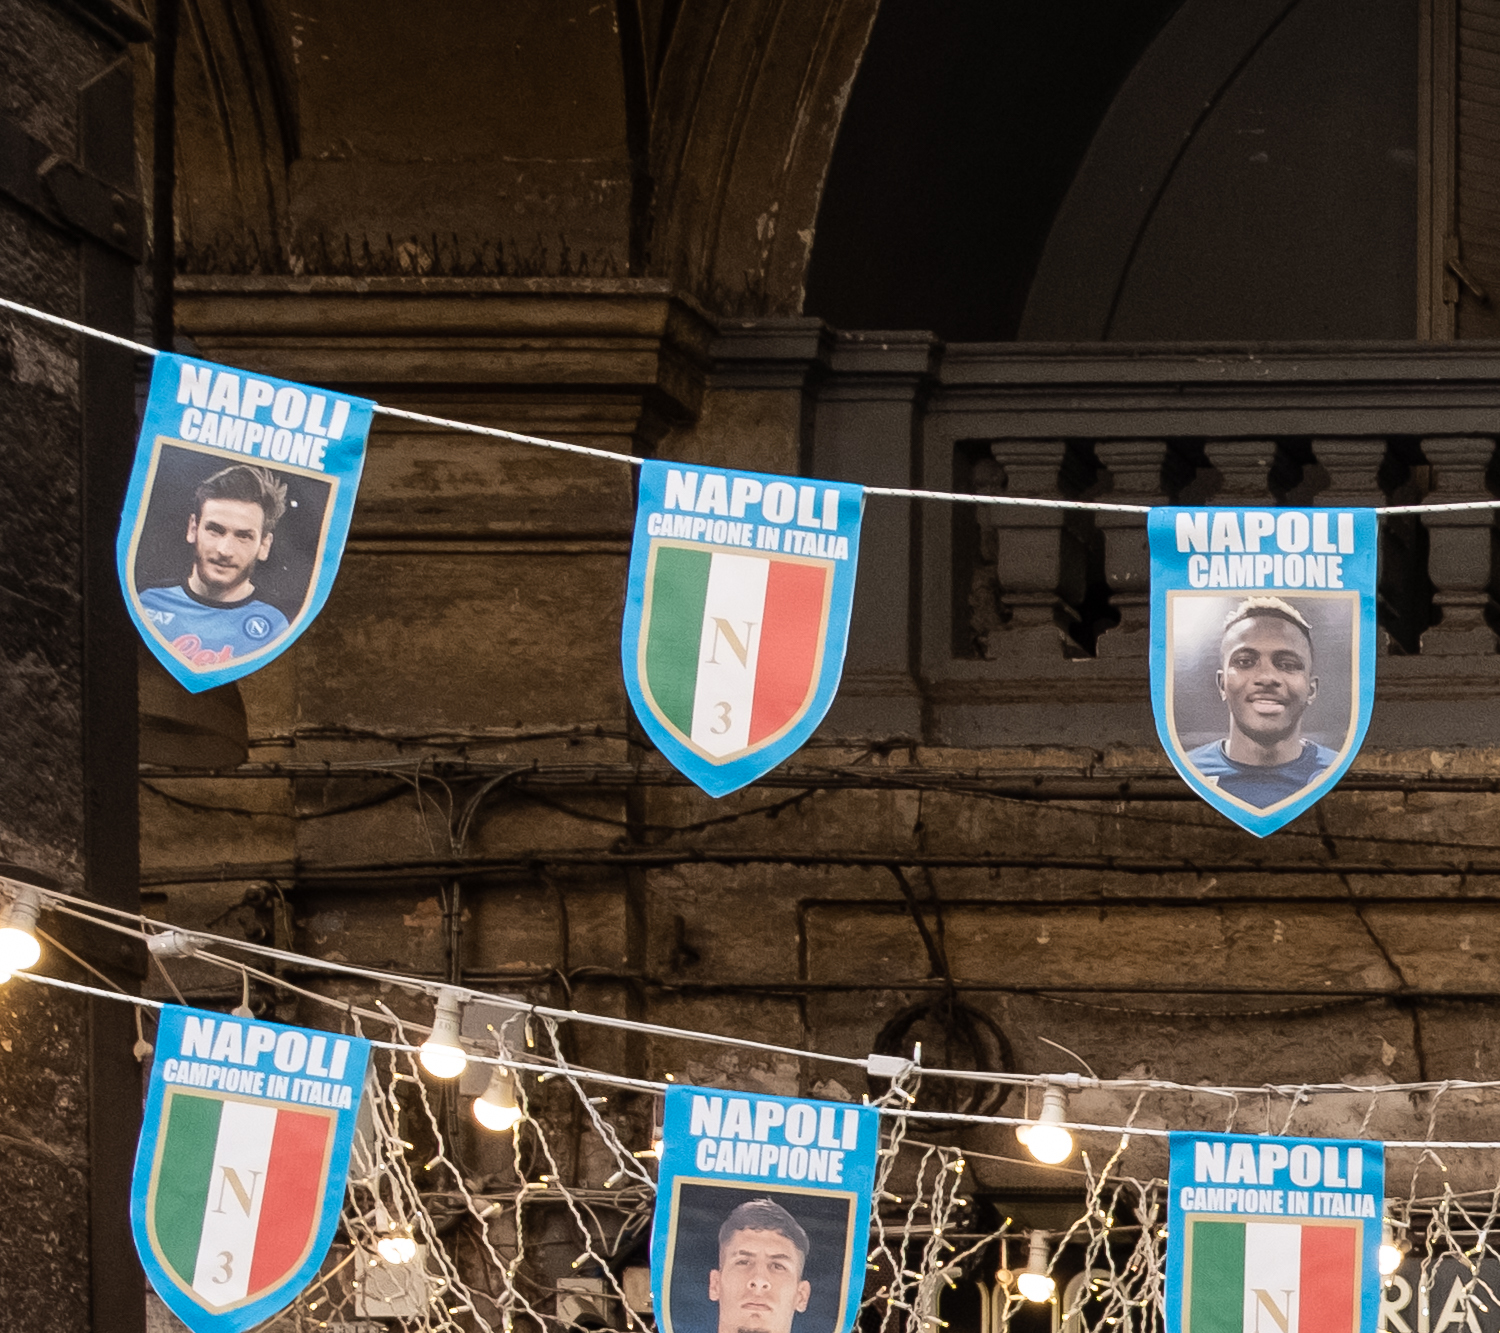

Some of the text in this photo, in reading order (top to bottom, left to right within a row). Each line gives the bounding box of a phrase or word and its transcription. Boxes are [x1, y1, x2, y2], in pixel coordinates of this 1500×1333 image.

[177, 363, 350, 440] NAPOLI
[179, 408, 329, 471] CAMPIONE
[664, 469, 840, 531] NAPOLI
[647, 513, 849, 561] CAMPIONE IN ITALIA
[1176, 512, 1355, 555] NAPOLI
[1187, 554, 1344, 589] CAMPIONE
[704, 616, 758, 669] N
[709, 701, 732, 735] 3
[181, 1016, 350, 1080] NAPOLI
[163, 1059, 353, 1111] CAMPIONE IN ITALIA
[690, 1095, 860, 1152] NAPOLI
[695, 1137, 844, 1184] CAMPIONE
[1193, 1142, 1363, 1189] NAPOLI
[215, 1165, 260, 1218] N
[1180, 1187, 1376, 1219] CAMPIONE IN ITALIA
[211, 1249, 235, 1285] 3
